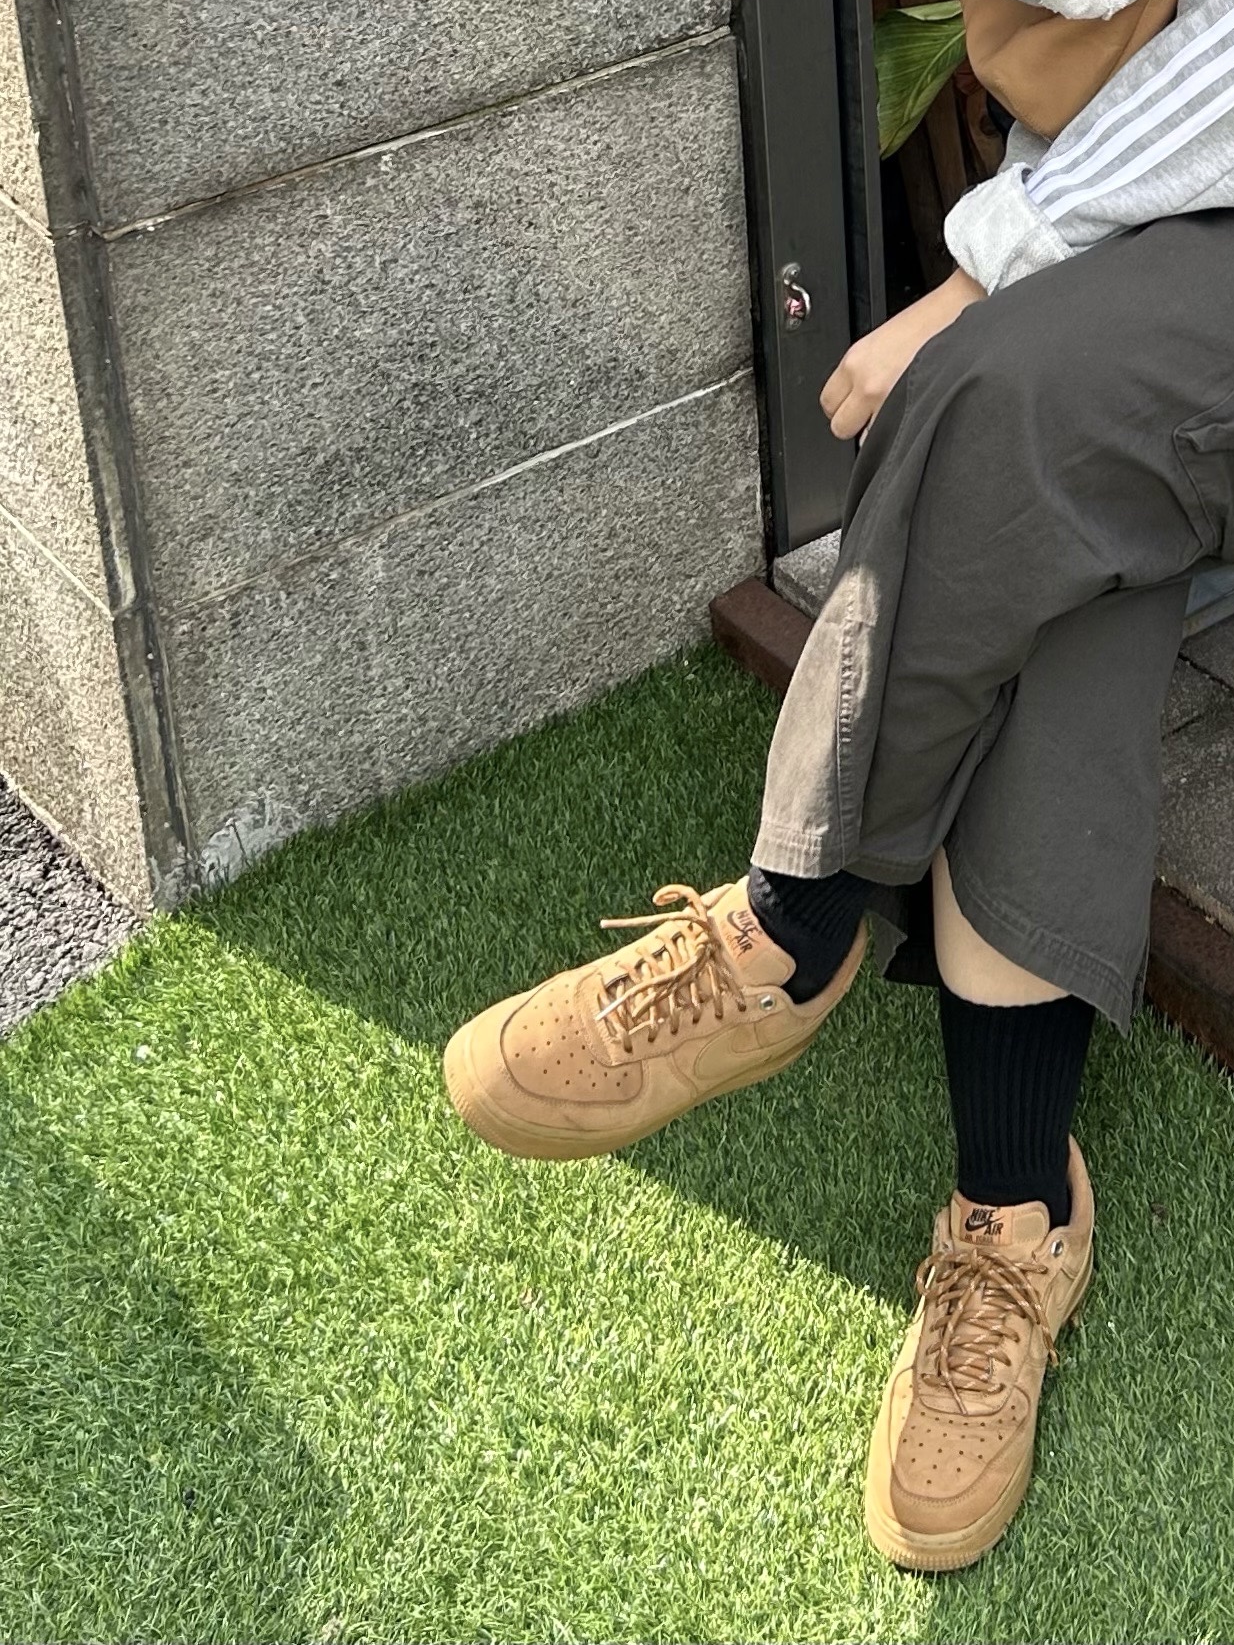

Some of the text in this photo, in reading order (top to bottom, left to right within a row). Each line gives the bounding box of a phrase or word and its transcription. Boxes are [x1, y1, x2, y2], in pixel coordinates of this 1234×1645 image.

[735, 909, 759, 934] NIKE
[733, 935, 753, 956] AIR
[970, 1207, 996, 1223] NIKE
[983, 1222, 1004, 1236] AIR
